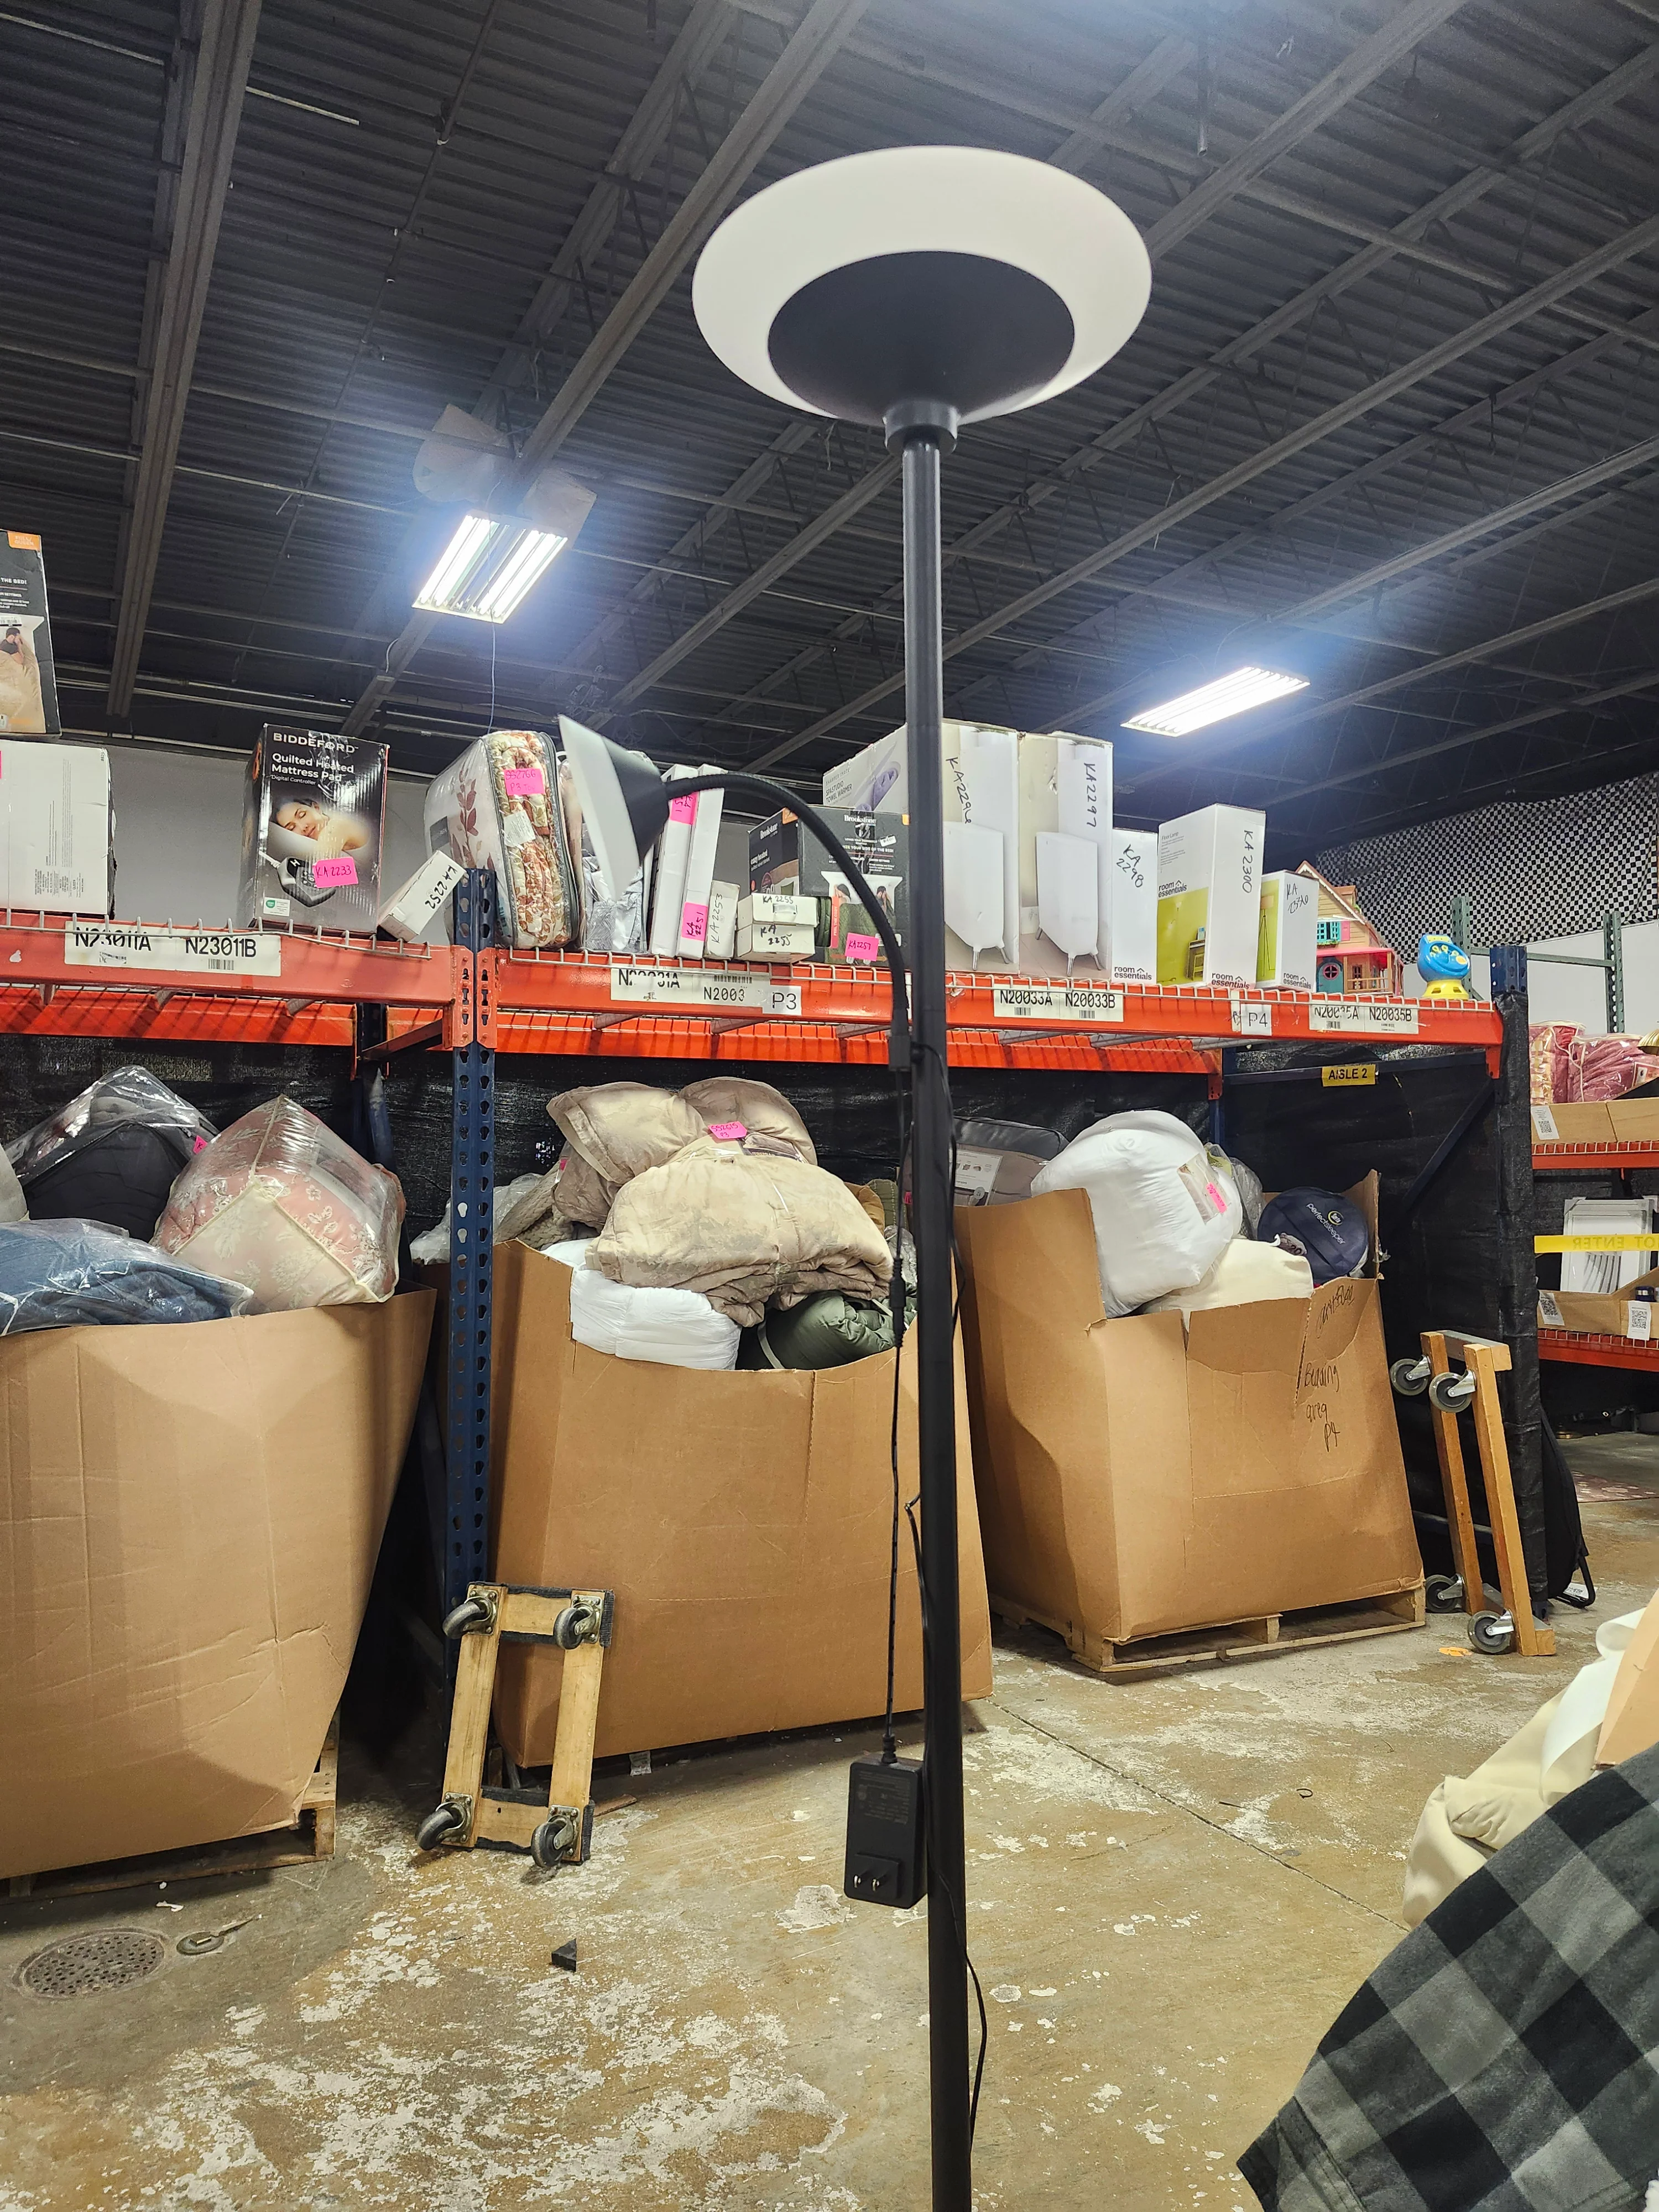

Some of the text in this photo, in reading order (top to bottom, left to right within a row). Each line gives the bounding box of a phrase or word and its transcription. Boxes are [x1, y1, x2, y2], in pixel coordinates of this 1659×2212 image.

[273, 732, 355, 753] BIDDEFORD
[272, 753, 354, 773] Quilted Heated
[272, 764, 342, 782] Mattress Pad
[290, 776, 316, 785] Controller
[826, 793, 837, 804] TOWEL
[838, 783, 852, 799] WARMER
[1084, 763, 1097, 827] KA2297
[1242, 854, 1253, 894] 2300
[1158, 884, 1187, 898] essentials
[1159, 881, 1175, 891] room
[775, 895, 794, 904] 2255
[185, 936, 257, 958] N23011B
[1114, 971, 1152, 980] essentials
[1212, 972, 1233, 981] room
[1284, 972, 1299, 981] room
[1211, 979, 1250, 990] essentials
[1283, 978, 1312, 989] essentials
[772, 992, 797, 1010] P3
[999, 990, 1115, 1009] N20033A N20033B
[1249, 1012, 1268, 1027] P4
[1369, 1007, 1412, 1022] N20035B
[1328, 1068, 1368, 1080] AISLE 2
[1331, 1213, 1341, 1224] Serta
